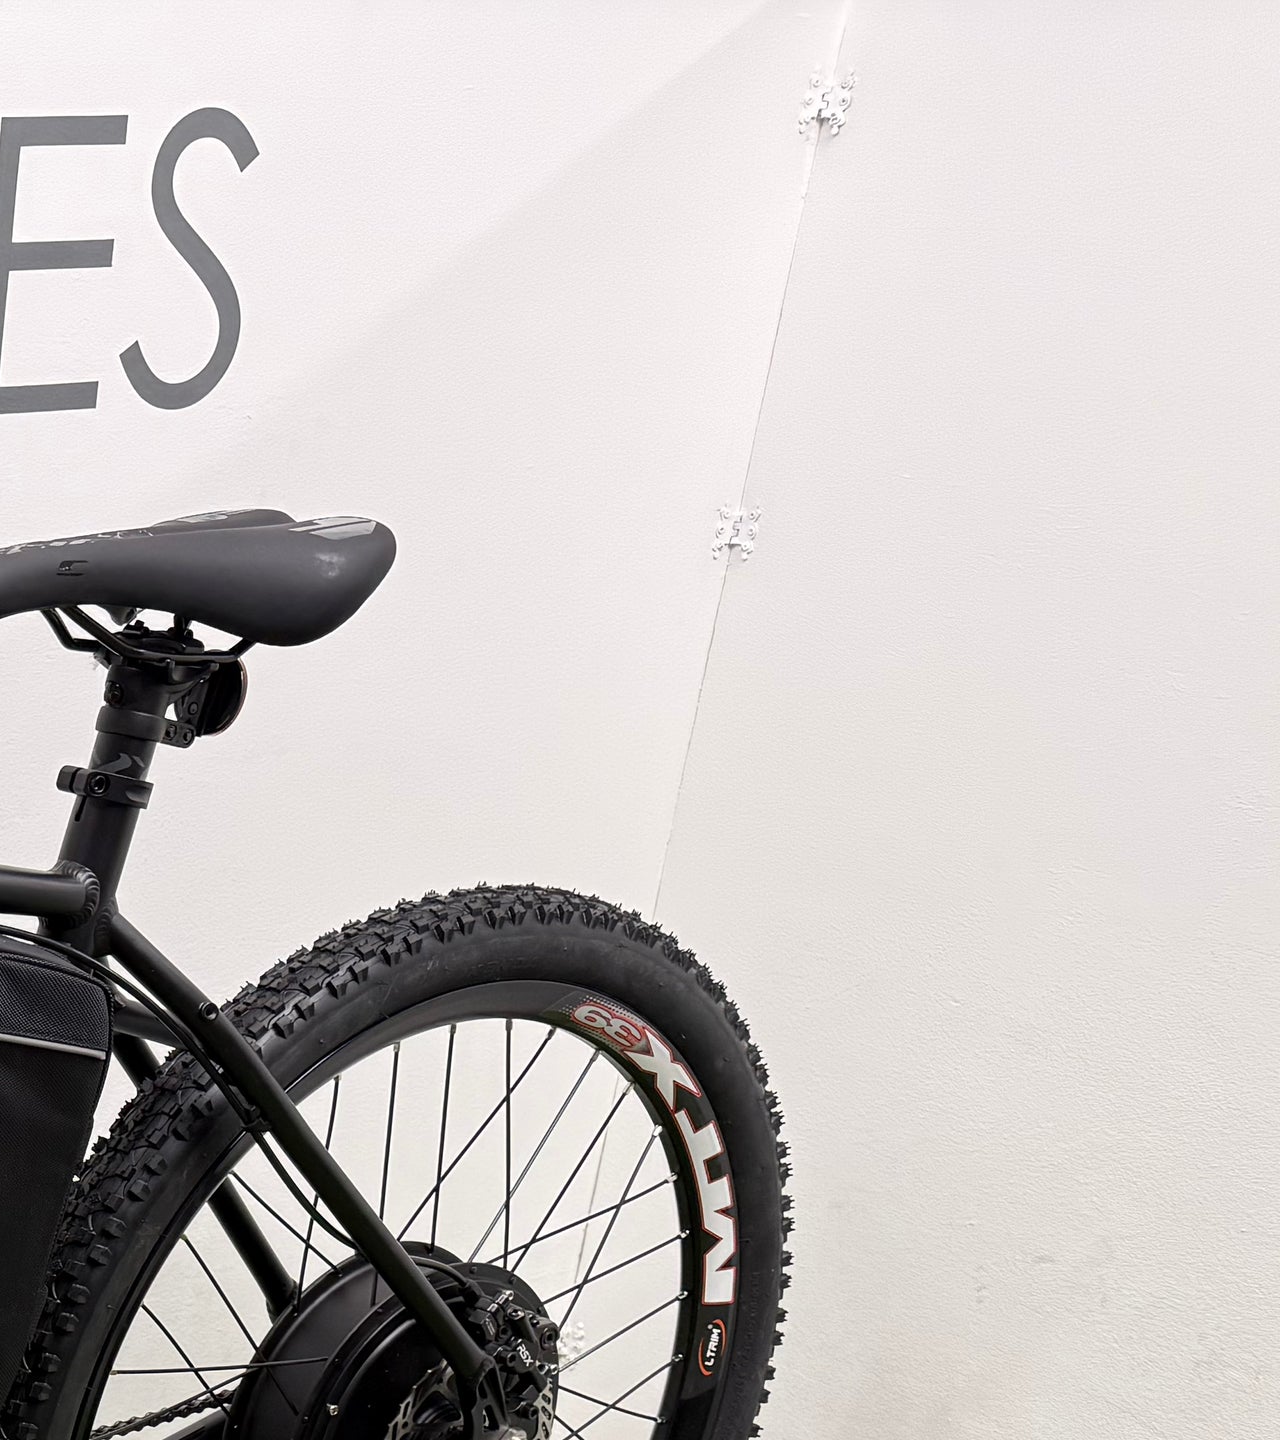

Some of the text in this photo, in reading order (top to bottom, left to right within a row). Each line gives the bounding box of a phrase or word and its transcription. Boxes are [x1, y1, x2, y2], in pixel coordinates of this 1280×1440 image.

[574, 1004, 738, 1306] MTX 39
[516, 1343, 534, 1367] RSX
